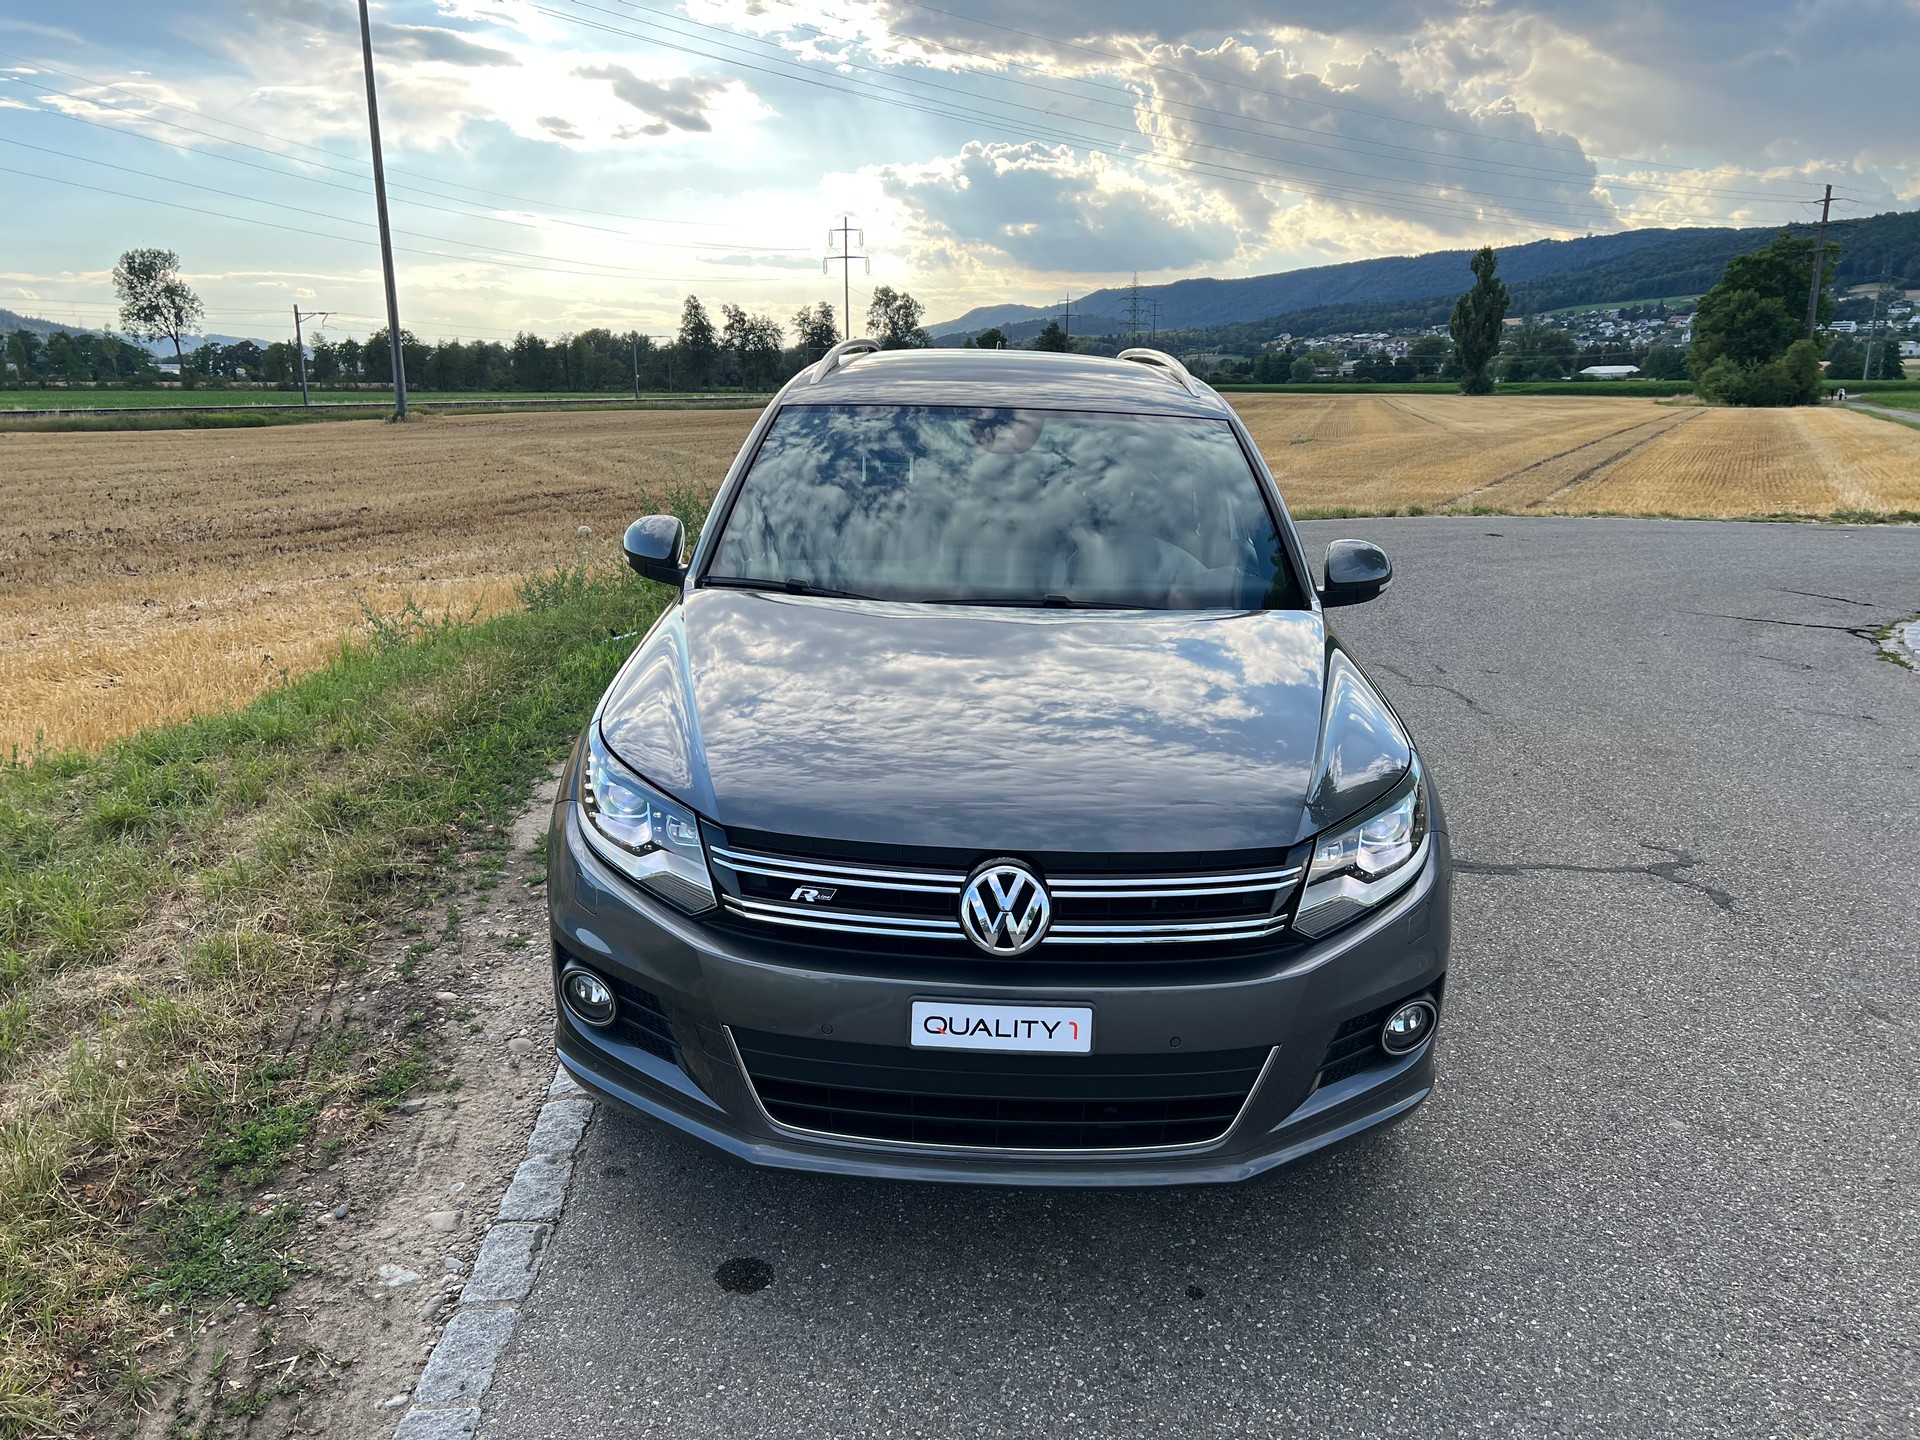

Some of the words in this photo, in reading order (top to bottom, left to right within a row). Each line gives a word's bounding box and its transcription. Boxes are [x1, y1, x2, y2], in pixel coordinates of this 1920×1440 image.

[790, 888, 819, 902] R
[964, 869, 1046, 953] VW
[923, 1015, 1062, 1039] QUALITY
[1068, 1021, 1078, 1040] 1
